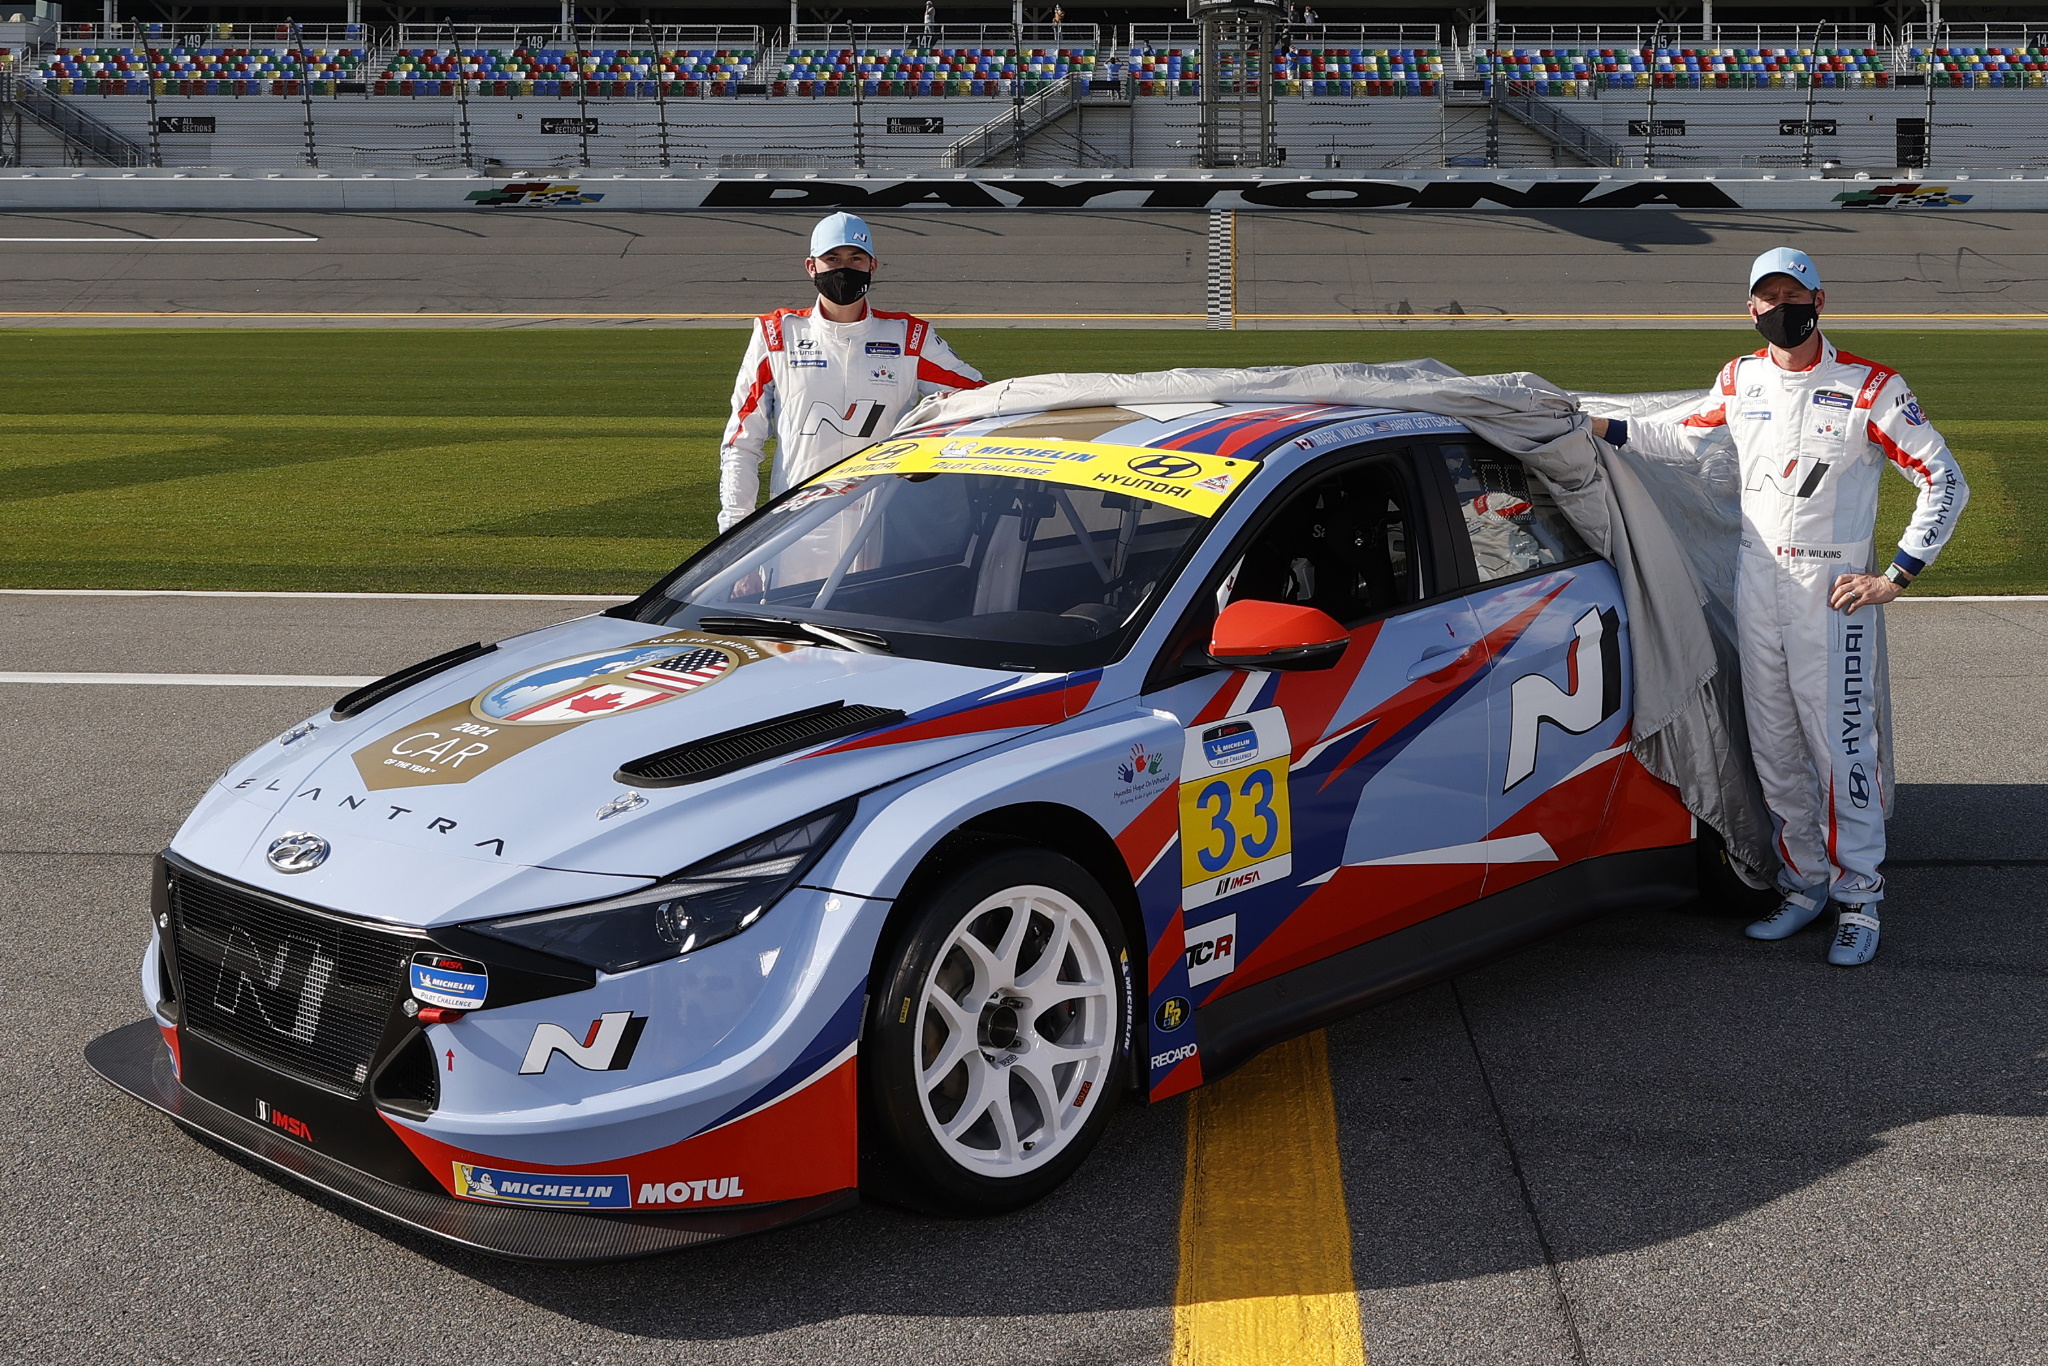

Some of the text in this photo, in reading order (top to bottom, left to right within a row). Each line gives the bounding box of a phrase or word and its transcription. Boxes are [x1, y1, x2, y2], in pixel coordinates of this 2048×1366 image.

[184, 34, 201, 48] 149
[526, 36, 543, 49] 148
[916, 35, 933, 49] 147
[181, 125, 212, 133] SECTIONS
[890, 118, 902, 126] ALL
[890, 125, 921, 133] SECTIONS
[700, 181, 1743, 208] DAYTONA
[909, 323, 924, 350] sparco
[1863, 371, 1888, 401] sparco
[1387, 418, 1416, 432] HARRY
[1310, 422, 1375, 448] MARK WILKINS
[976, 445, 1099, 463] MICHELIN
[835, 461, 900, 477] HYUNDAI
[929, 461, 1053, 476] PILOT CHALLENGE
[1092, 471, 1192, 499] HYUNDAI
[1935, 469, 1958, 526] HYUNDAI
[1796, 548, 1842, 559] M. WILKINS
[711, 639, 761, 660] AMERICAN
[1841, 624, 1864, 756] HYUNDAI
[451, 722, 499, 738] 2021
[391, 732, 489, 769] CAR
[1222, 738, 1250, 751] MICHELIN
[383, 758, 398, 766] OF
[394, 760, 412, 769] THE
[235, 777, 506, 858] ELANTRA
[1195, 768, 1279, 873] 33
[1229, 870, 1261, 890] IMSA
[1185, 933, 1234, 970] TCR
[438, 959, 464, 970] IMSA
[431, 978, 476, 991] MICHELIN
[420, 992, 473, 1008] PILOT CHALLENGE
[1123, 976, 1133, 1051] MICHELIN
[1150, 1042, 1198, 1070] RECARO
[272, 1109, 314, 1143] IMSA
[500, 1180, 614, 1199] MICHELIN
[637, 1176, 745, 1205] MOTUL
